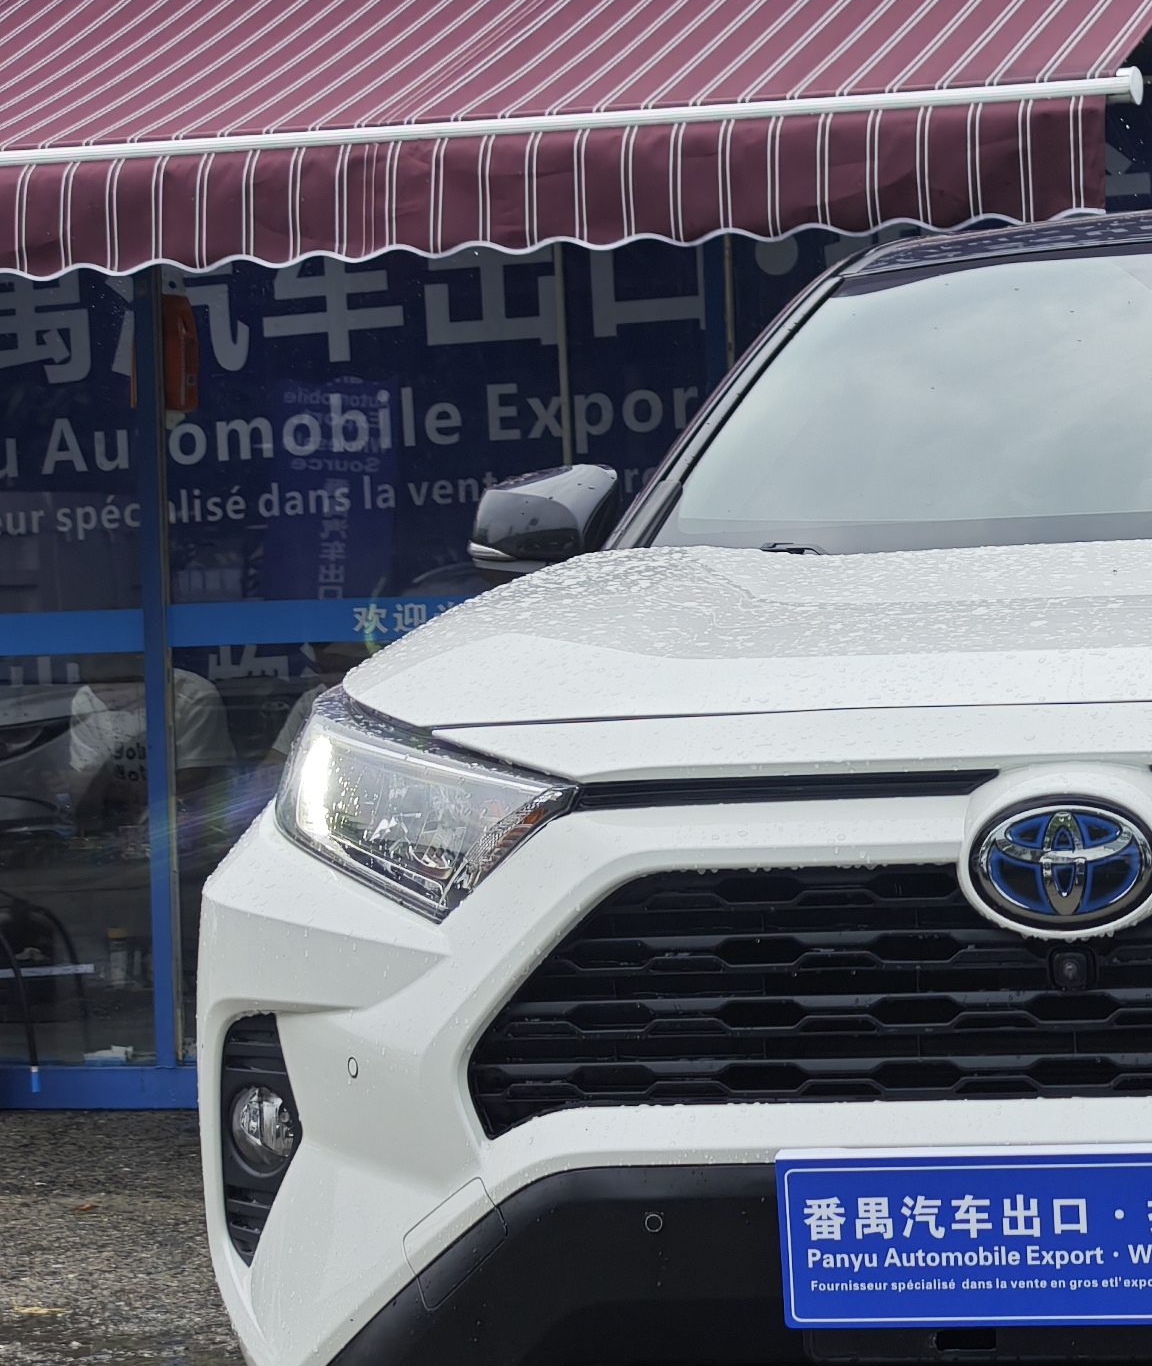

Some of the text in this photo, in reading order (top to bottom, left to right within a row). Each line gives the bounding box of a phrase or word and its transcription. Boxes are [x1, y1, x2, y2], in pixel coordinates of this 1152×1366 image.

[41, 386, 463, 475] Auomobile
[258, 482, 350, 519] dans
[363, 475, 396, 510] la
[353, 602, 455, 634] 欢迎
[803, 1194, 1089, 1241] 番禺汽车出口
[807, 1248, 878, 1273] Panyu
[883, 1245, 1021, 1268] Automobile
[1026, 1245, 1105, 1270] Export
[810, 1279, 889, 1292] Fournisseur
[890, 1278, 956, 1293] spécialisé
[961, 1278, 993, 1290] dans
[995, 1277, 1008, 1289] la
[1010, 1279, 1048, 1289] vente
[1050, 1279, 1066, 1289] en
[1069, 1279, 1099, 1291] gros
